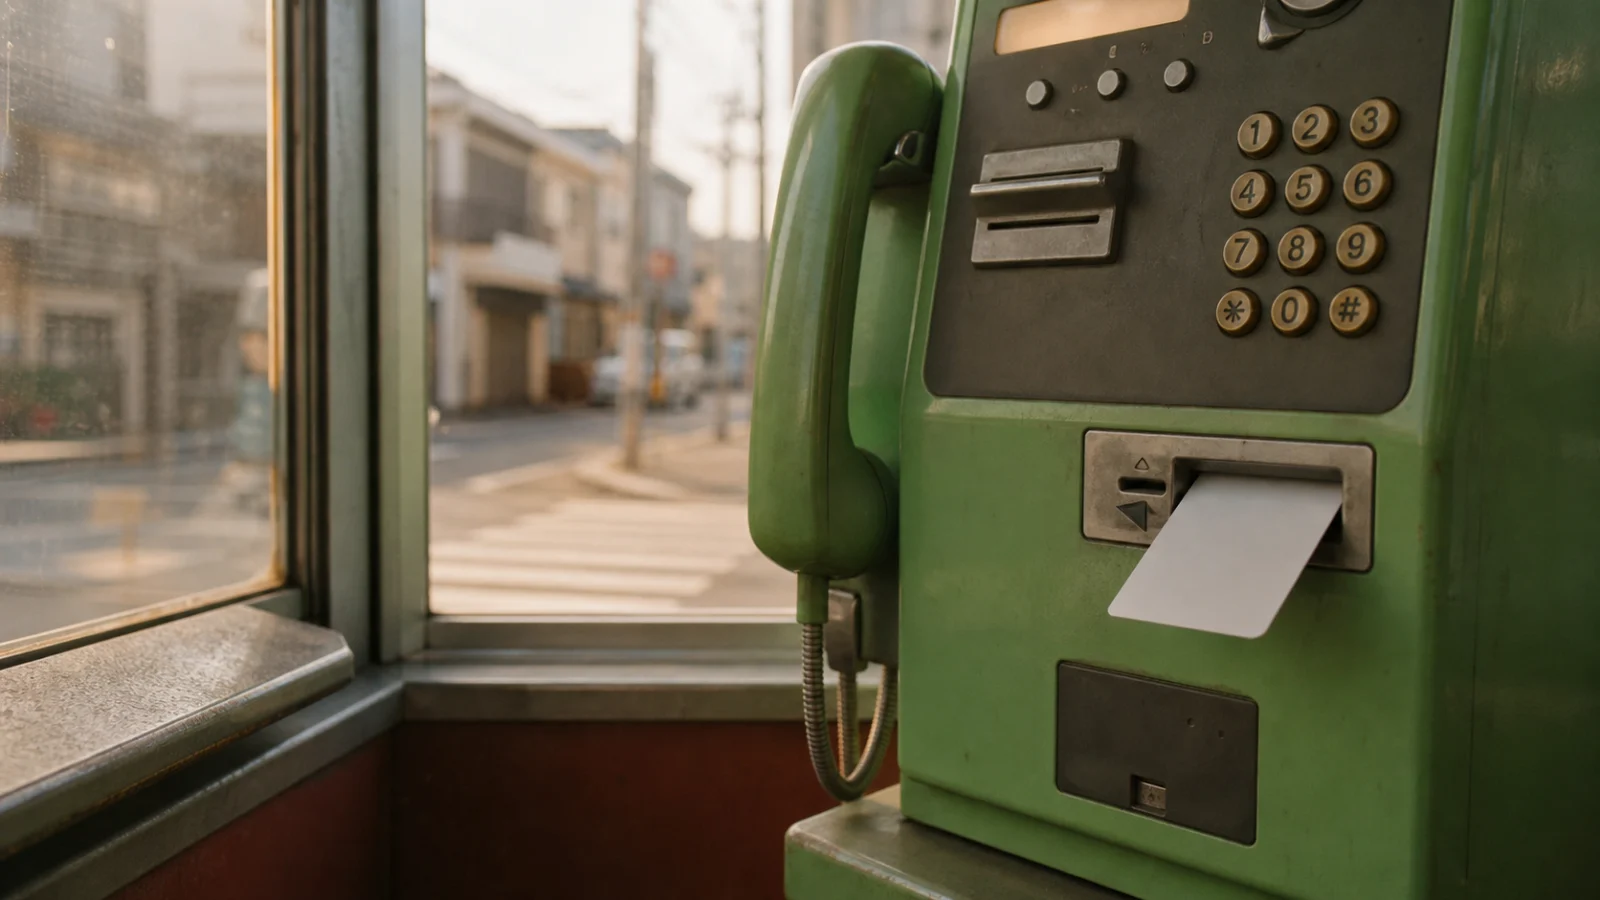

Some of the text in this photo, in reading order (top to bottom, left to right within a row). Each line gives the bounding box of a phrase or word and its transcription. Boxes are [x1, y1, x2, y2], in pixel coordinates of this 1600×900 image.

[1250, 106, 1379, 145] 1 2 3
[1238, 168, 1373, 204] 4 5 6
[1234, 231, 1366, 264] 7 8 9
[1281, 296, 1299, 323] 0
[1337, 296, 1361, 323] #
